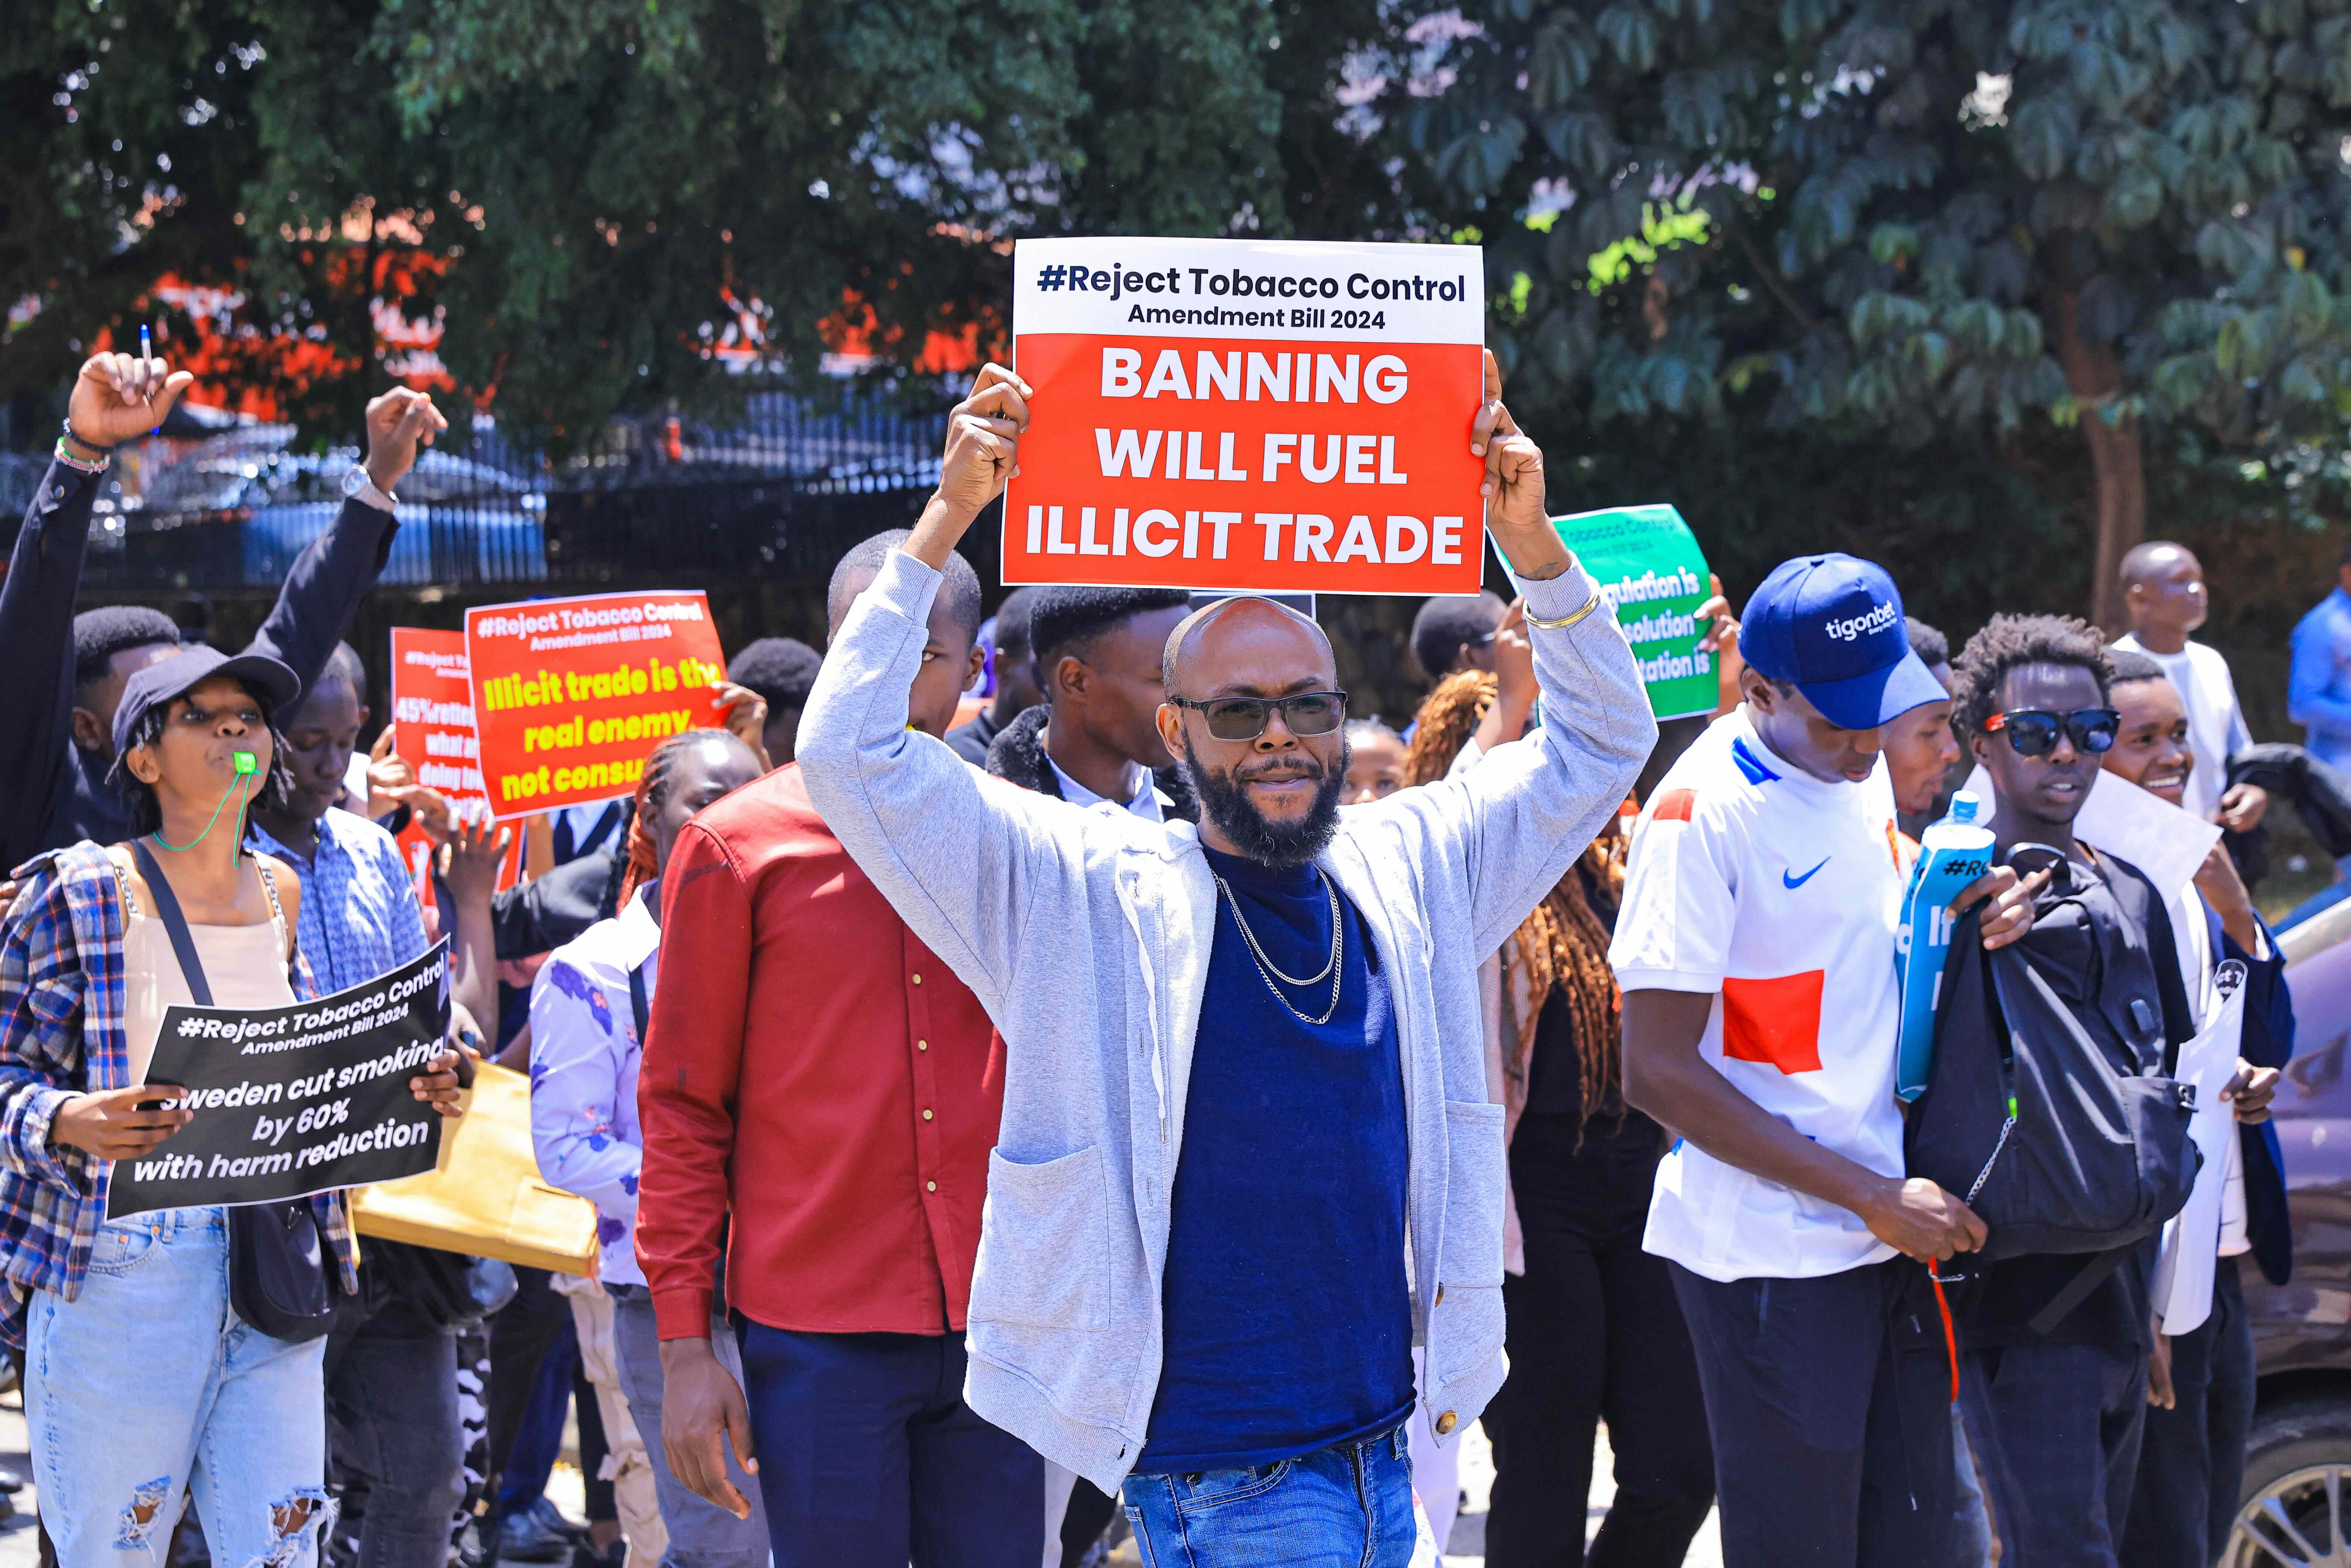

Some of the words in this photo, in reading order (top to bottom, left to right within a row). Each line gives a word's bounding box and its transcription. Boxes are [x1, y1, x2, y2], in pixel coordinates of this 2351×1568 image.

[1037, 263, 1180, 300] #Reject
[1189, 268, 1338, 299] Tobacco
[1347, 273, 1465, 301] Control
[1128, 305, 1285, 327] Amendment
[1292, 308, 1324, 328] Bill
[1330, 310, 1386, 329] 2024
[1101, 347, 1408, 404] BANNING
[1095, 428, 1247, 481] WILL
[1263, 433, 1407, 484] FUEL
[1026, 505, 1242, 559] ILLICIT
[1254, 513, 1464, 565] TRADE
[1602, 569, 1682, 615] gulation
[1677, 565, 1700, 595] is
[478, 611, 559, 640] #Reject
[560, 607, 643, 629] Tobacco
[643, 601, 704, 621] Control
[530, 630, 619, 651] Amendment
[619, 624, 640, 642] Bill
[640, 623, 672, 640] 2024
[1622, 609, 1695, 644] solution
[1825, 599, 1895, 641] tigonbet
[1693, 646, 1711, 675] is
[483, 669, 563, 711] Illicit
[565, 664, 648, 701] trade
[650, 657, 678, 692] is
[524, 715, 584, 753] real
[501, 765, 550, 801] not
[553, 757, 646, 792] consu
[177, 1016, 289, 1044] #Reject
[293, 992, 385, 1032] Tobacco
[388, 952, 445, 1003] Control
[240, 1023, 350, 1056] Amendment
[351, 1014, 375, 1035] Bill
[375, 1002, 409, 1028] 2024
[287, 1071, 335, 1102] cut
[252, 1114, 294, 1147] by
[296, 1097, 351, 1132] 60%
[134, 1152, 204, 1182] with
[207, 1148, 294, 1179] harm
[294, 1116, 429, 1170] reduction
